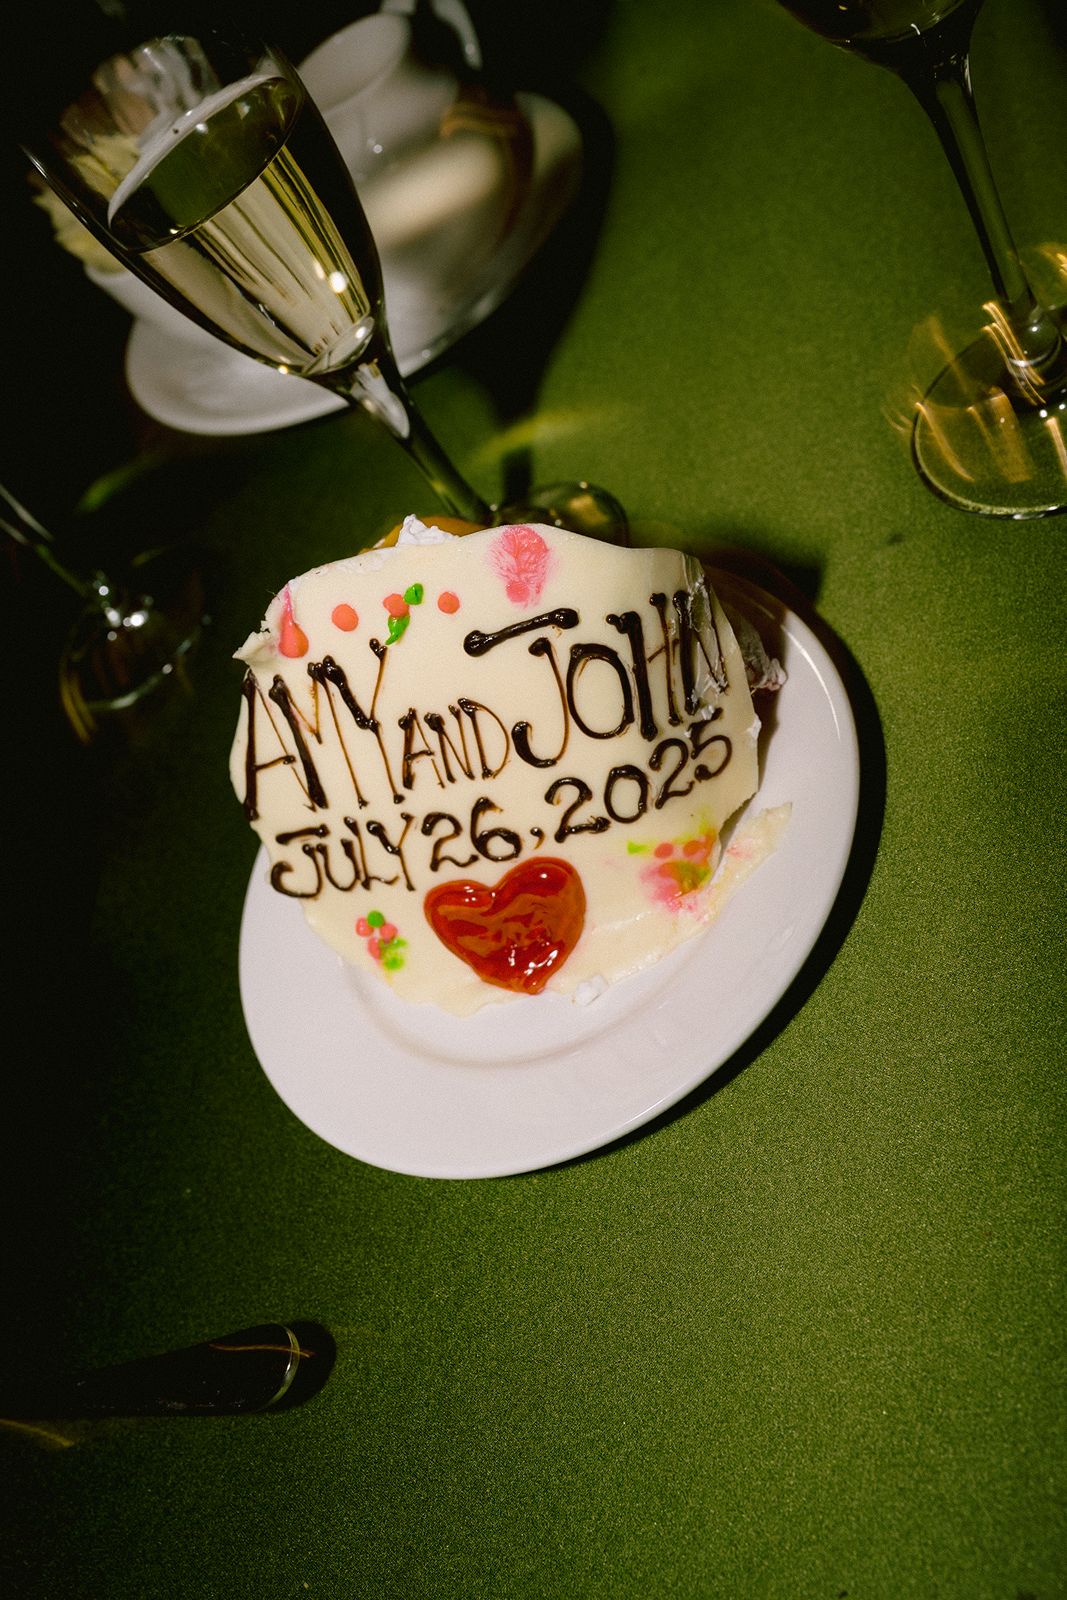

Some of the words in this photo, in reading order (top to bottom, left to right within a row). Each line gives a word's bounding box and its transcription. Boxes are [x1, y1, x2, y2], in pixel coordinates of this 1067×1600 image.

[244, 638, 405, 821] AMY
[398, 698, 509, 789] AND
[463, 589, 728, 768] JOHN
[271, 813, 416, 899] JULY
[421, 797, 545, 872] 26,
[544, 707, 732, 843] 2025
